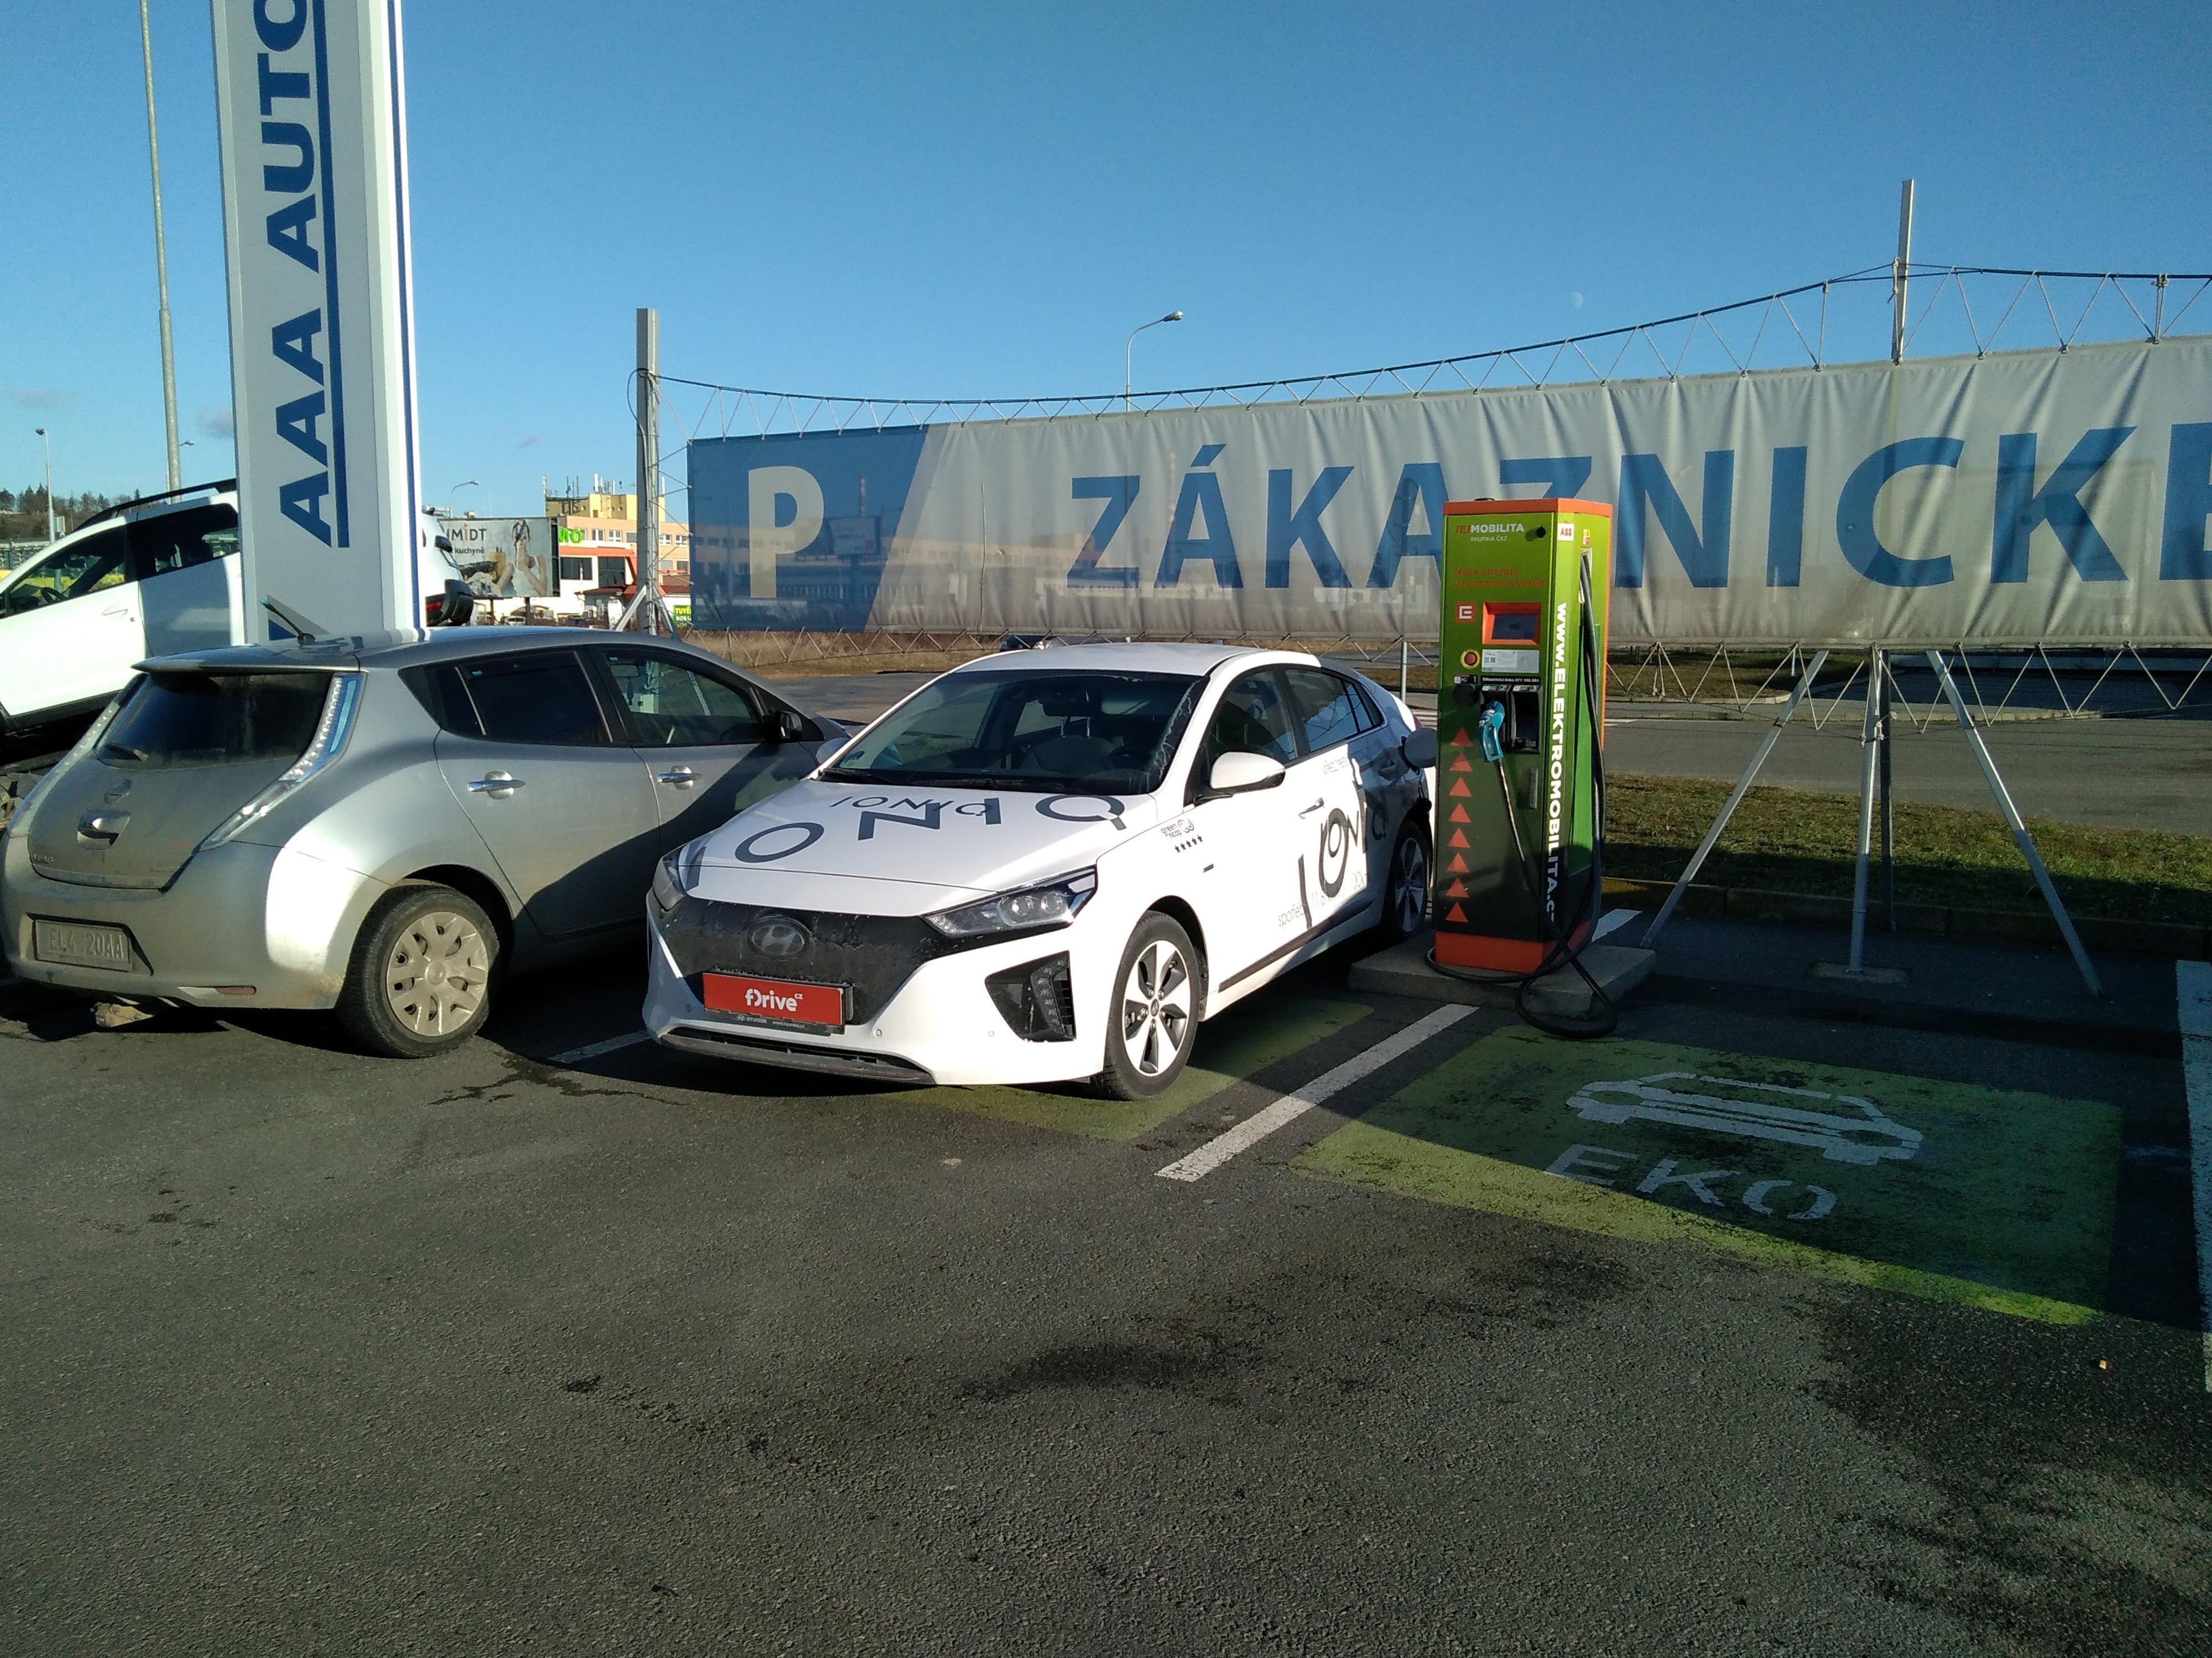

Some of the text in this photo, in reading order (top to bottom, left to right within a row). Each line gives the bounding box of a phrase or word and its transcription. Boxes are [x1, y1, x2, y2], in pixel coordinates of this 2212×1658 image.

[253, 0, 332, 548] AAA AUTO
[748, 466, 825, 598] P
[1561, 527, 1572, 536] ABB
[830, 796, 995, 817] IONIQ
[1161, 824, 1178, 836] green
[745, 987, 798, 1012] fDrive
[1543, 1143, 1839, 1220] EKO
